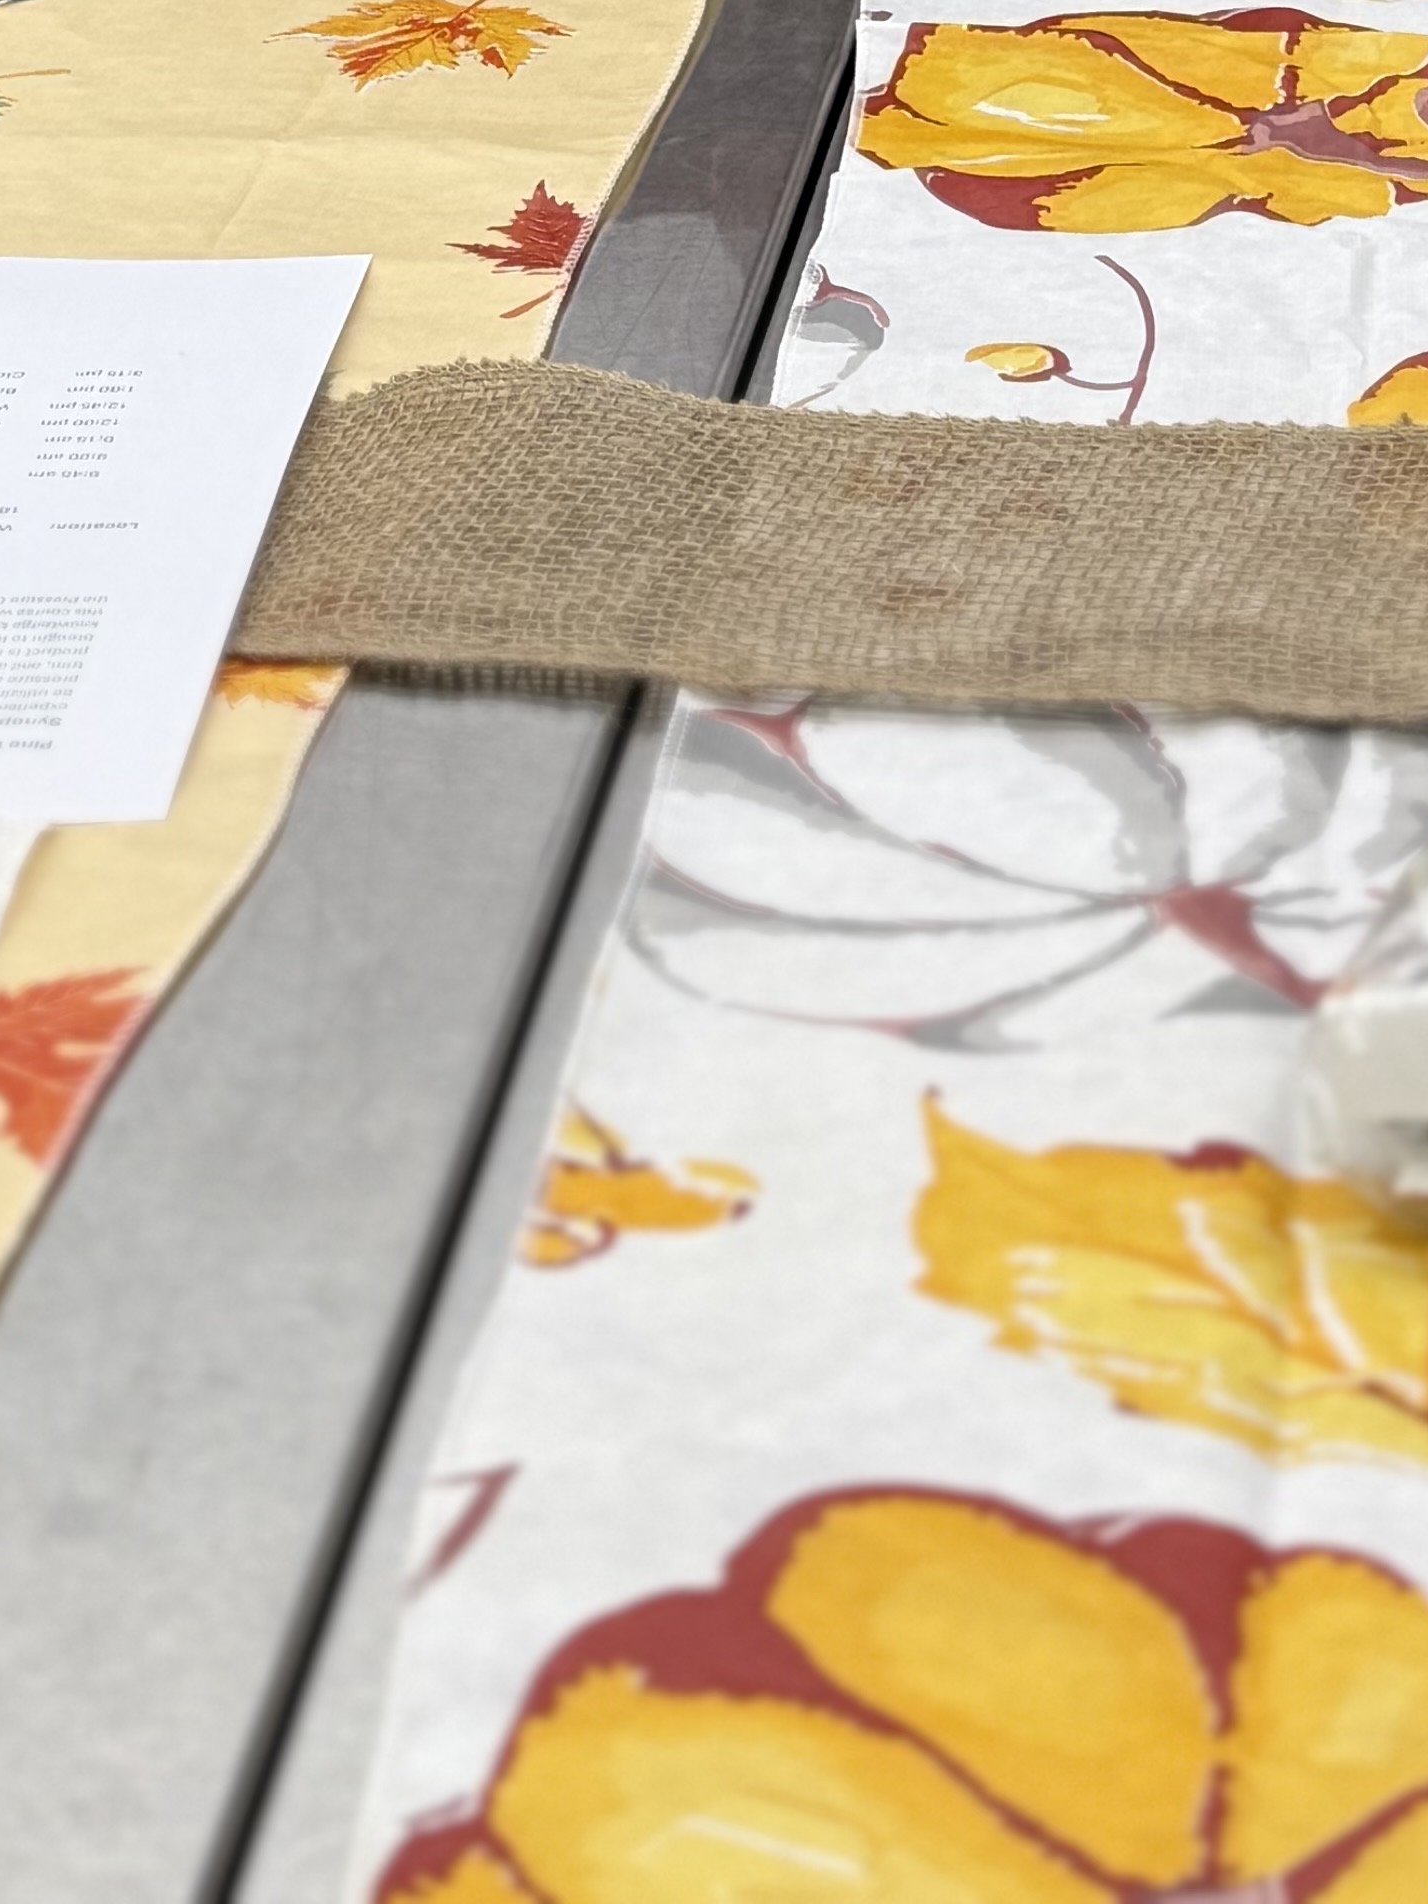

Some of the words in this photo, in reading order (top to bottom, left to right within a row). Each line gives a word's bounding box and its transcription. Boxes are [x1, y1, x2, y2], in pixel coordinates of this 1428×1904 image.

[66, 385, 95, 393] pm
[49, 401, 77, 409] pm
[40, 418, 69, 426] pm
[50, 522, 139, 530] Location:
[7, 675, 79, 683] pressure
[53, 689, 73, 697] be
[9, 741, 52, 750] Pine
